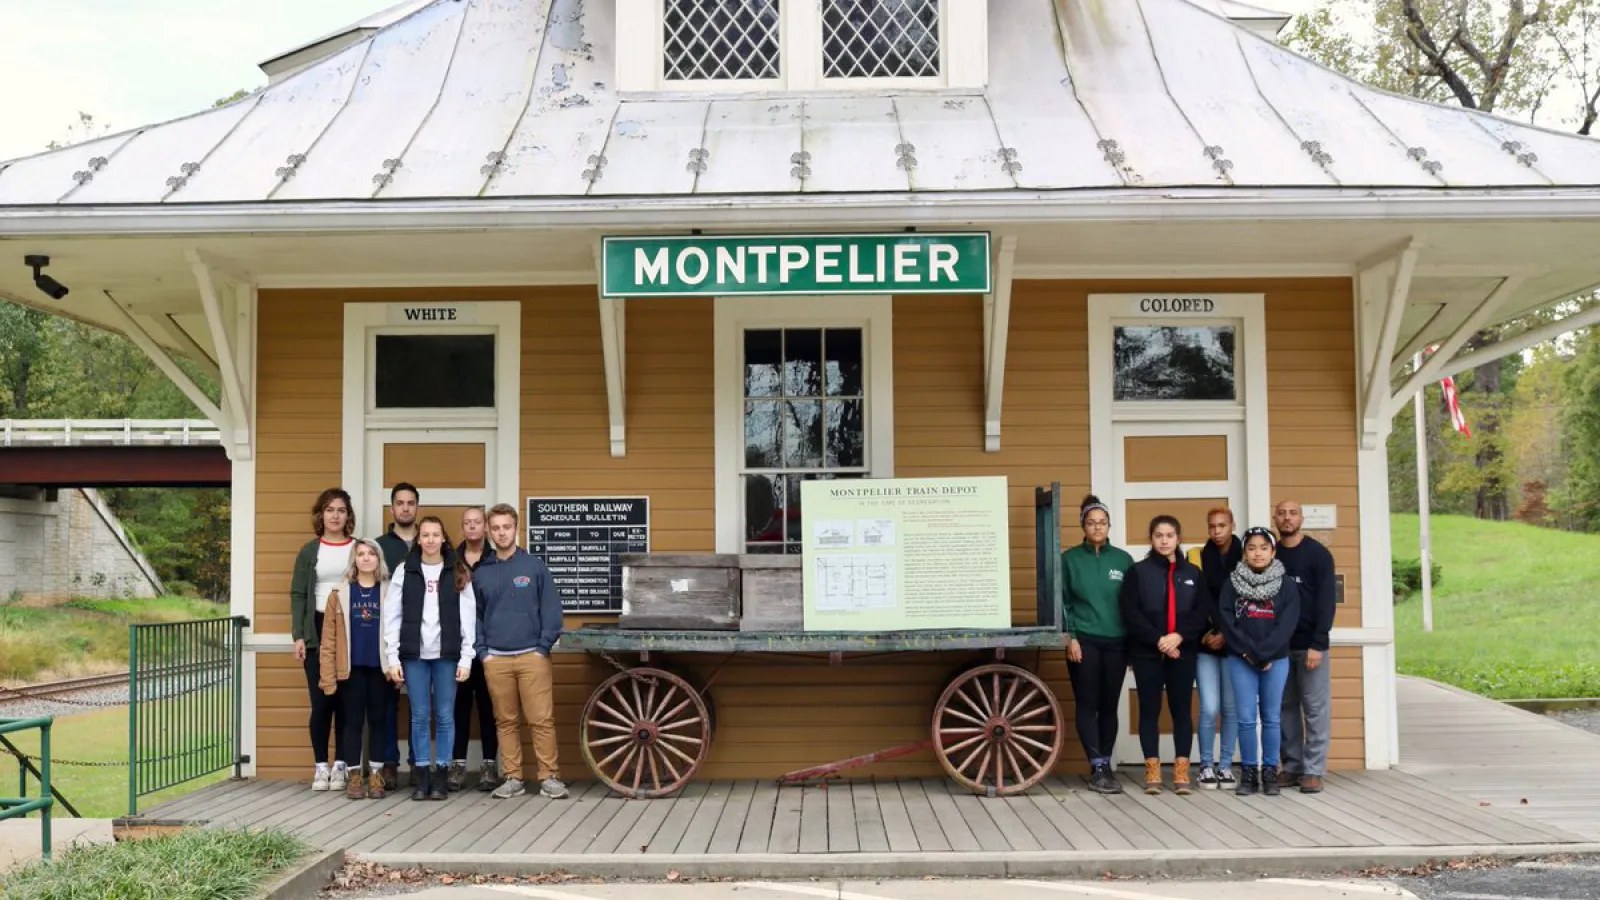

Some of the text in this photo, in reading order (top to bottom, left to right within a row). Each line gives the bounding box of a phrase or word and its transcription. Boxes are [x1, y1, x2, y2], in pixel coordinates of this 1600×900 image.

[633, 243, 960, 286] MONTPELIER
[1140, 298, 1214, 313] COLORED
[403, 307, 457, 321] WHITE
[829, 485, 978, 497] MONTPELIER TRAIN DEPOT
[538, 503, 633, 513] SOUTHERN RAILWAY
[540, 514, 581, 522] SCHEDULE
